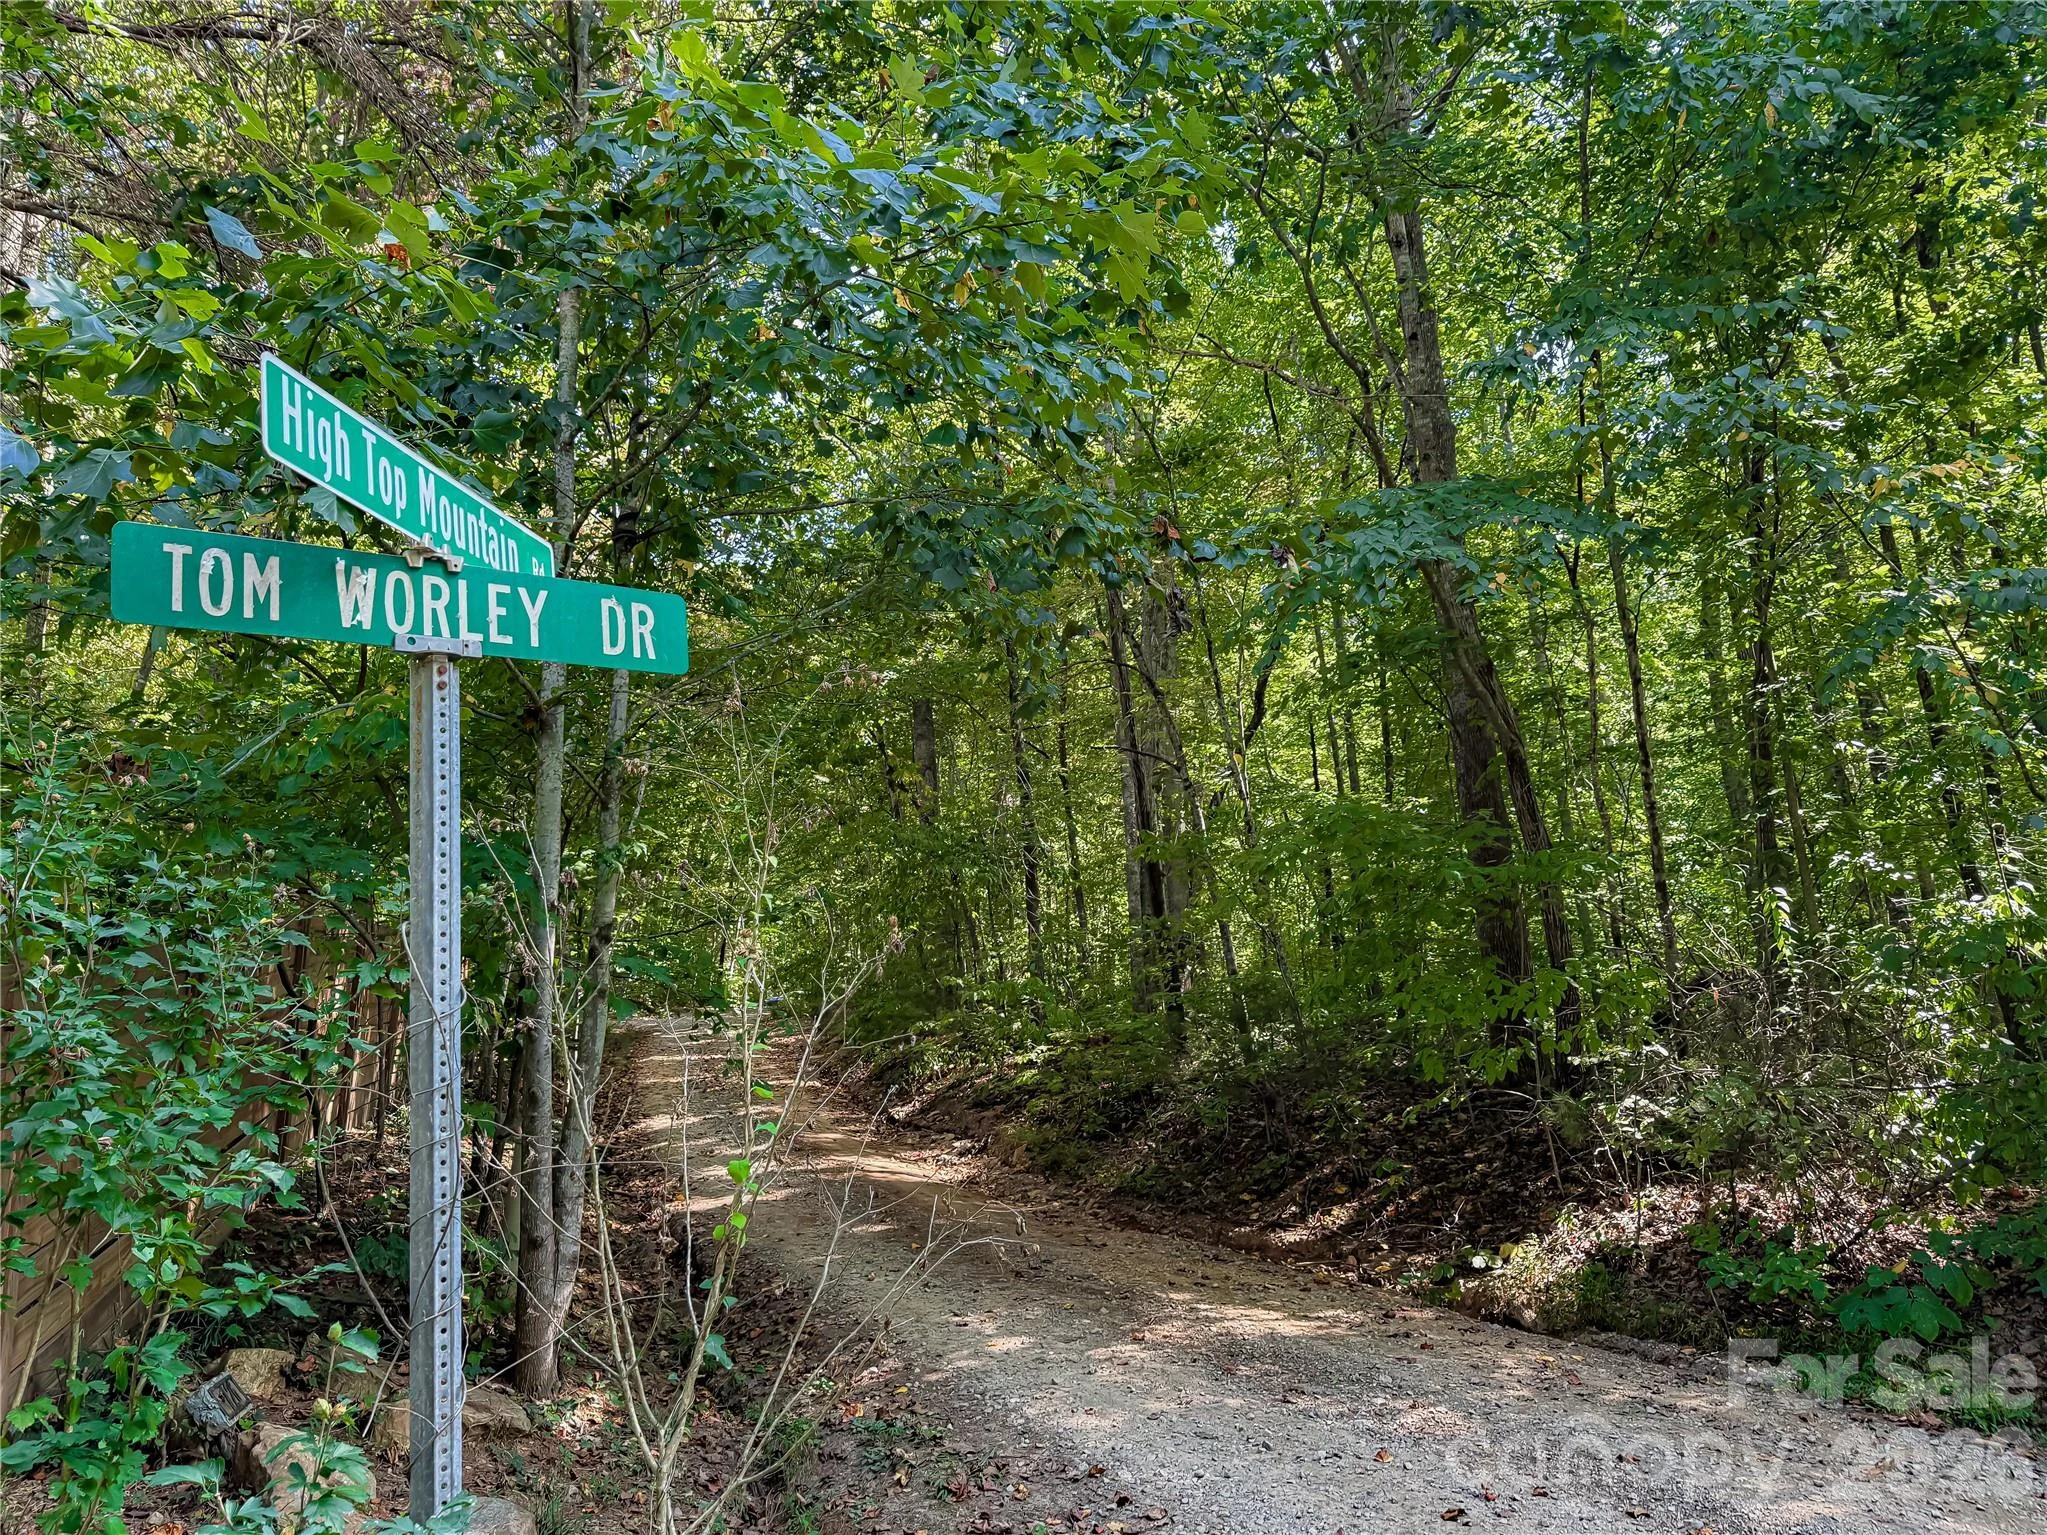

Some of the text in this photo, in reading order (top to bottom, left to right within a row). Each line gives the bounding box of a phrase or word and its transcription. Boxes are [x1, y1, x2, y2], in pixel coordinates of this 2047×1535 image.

[281, 373, 351, 483] High
[361, 427, 407, 520] Top
[418, 465, 520, 573] Mountain
[162, 542, 656, 660] TOM WORLEY DR
